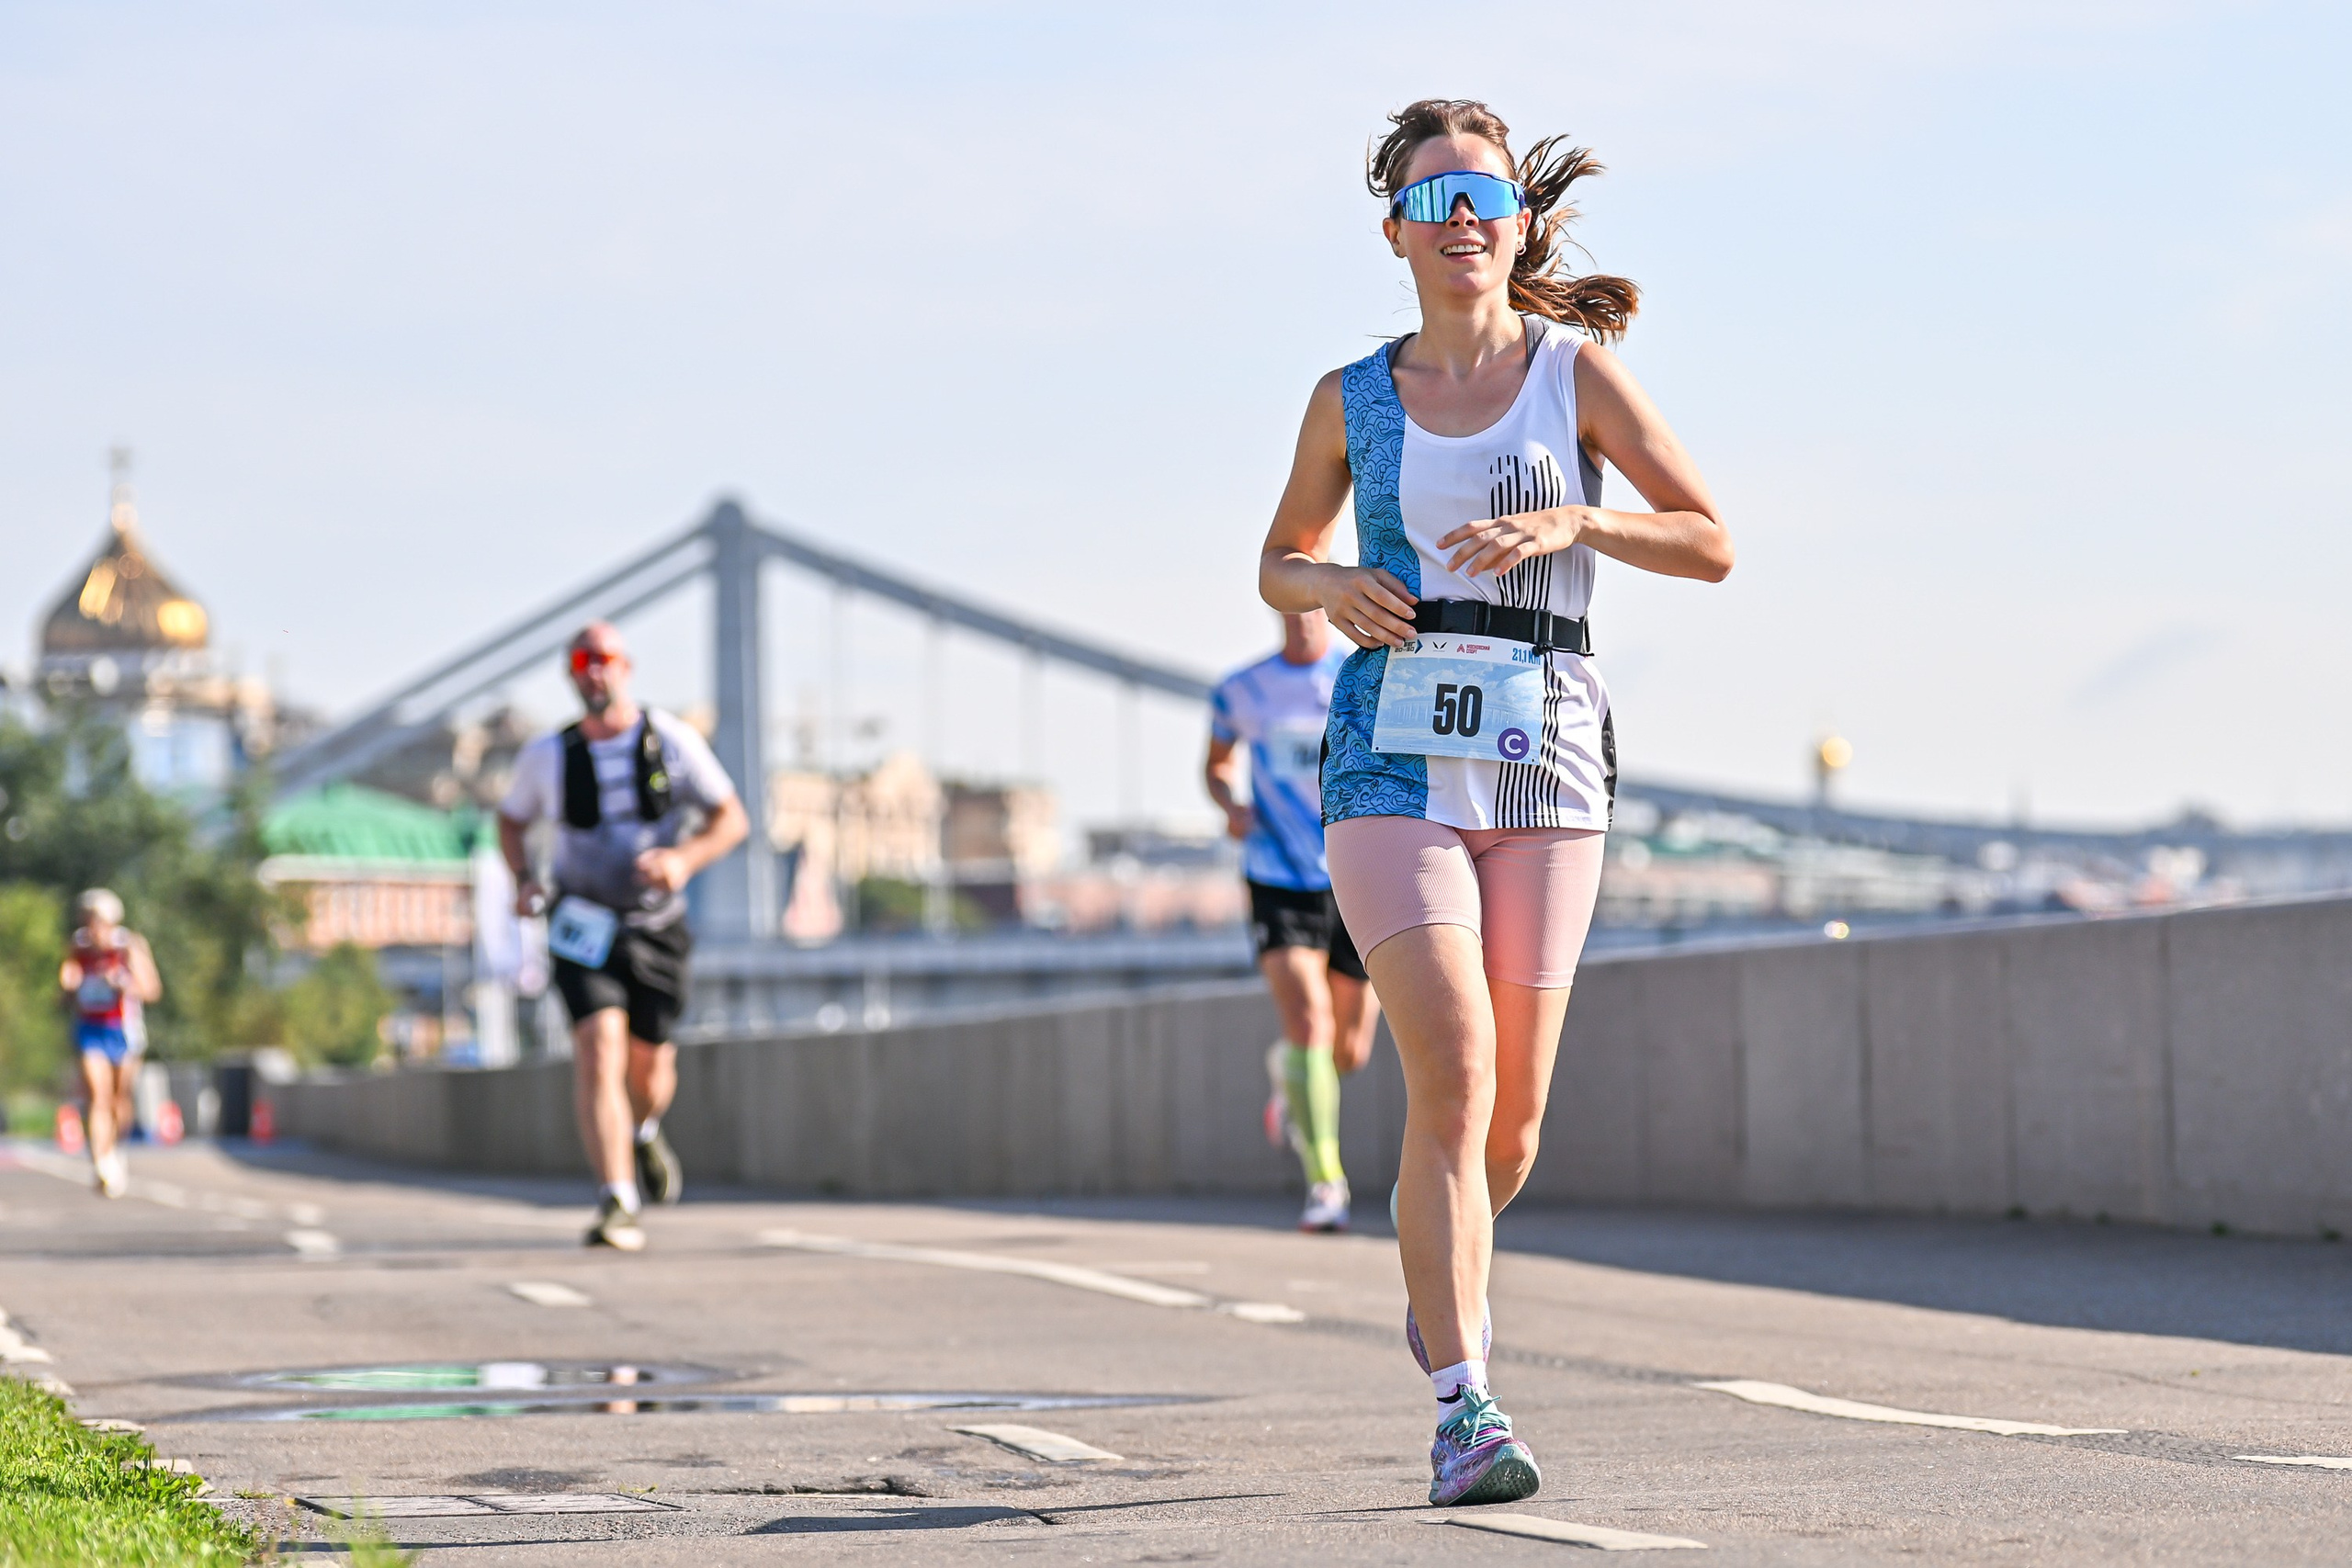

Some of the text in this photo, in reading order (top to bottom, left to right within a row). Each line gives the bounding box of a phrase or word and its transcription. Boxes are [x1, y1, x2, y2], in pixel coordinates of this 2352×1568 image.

[1511, 648, 1527, 663] 21,1
[1432, 683, 1483, 738] 50
[1504, 734, 1523, 754] C
